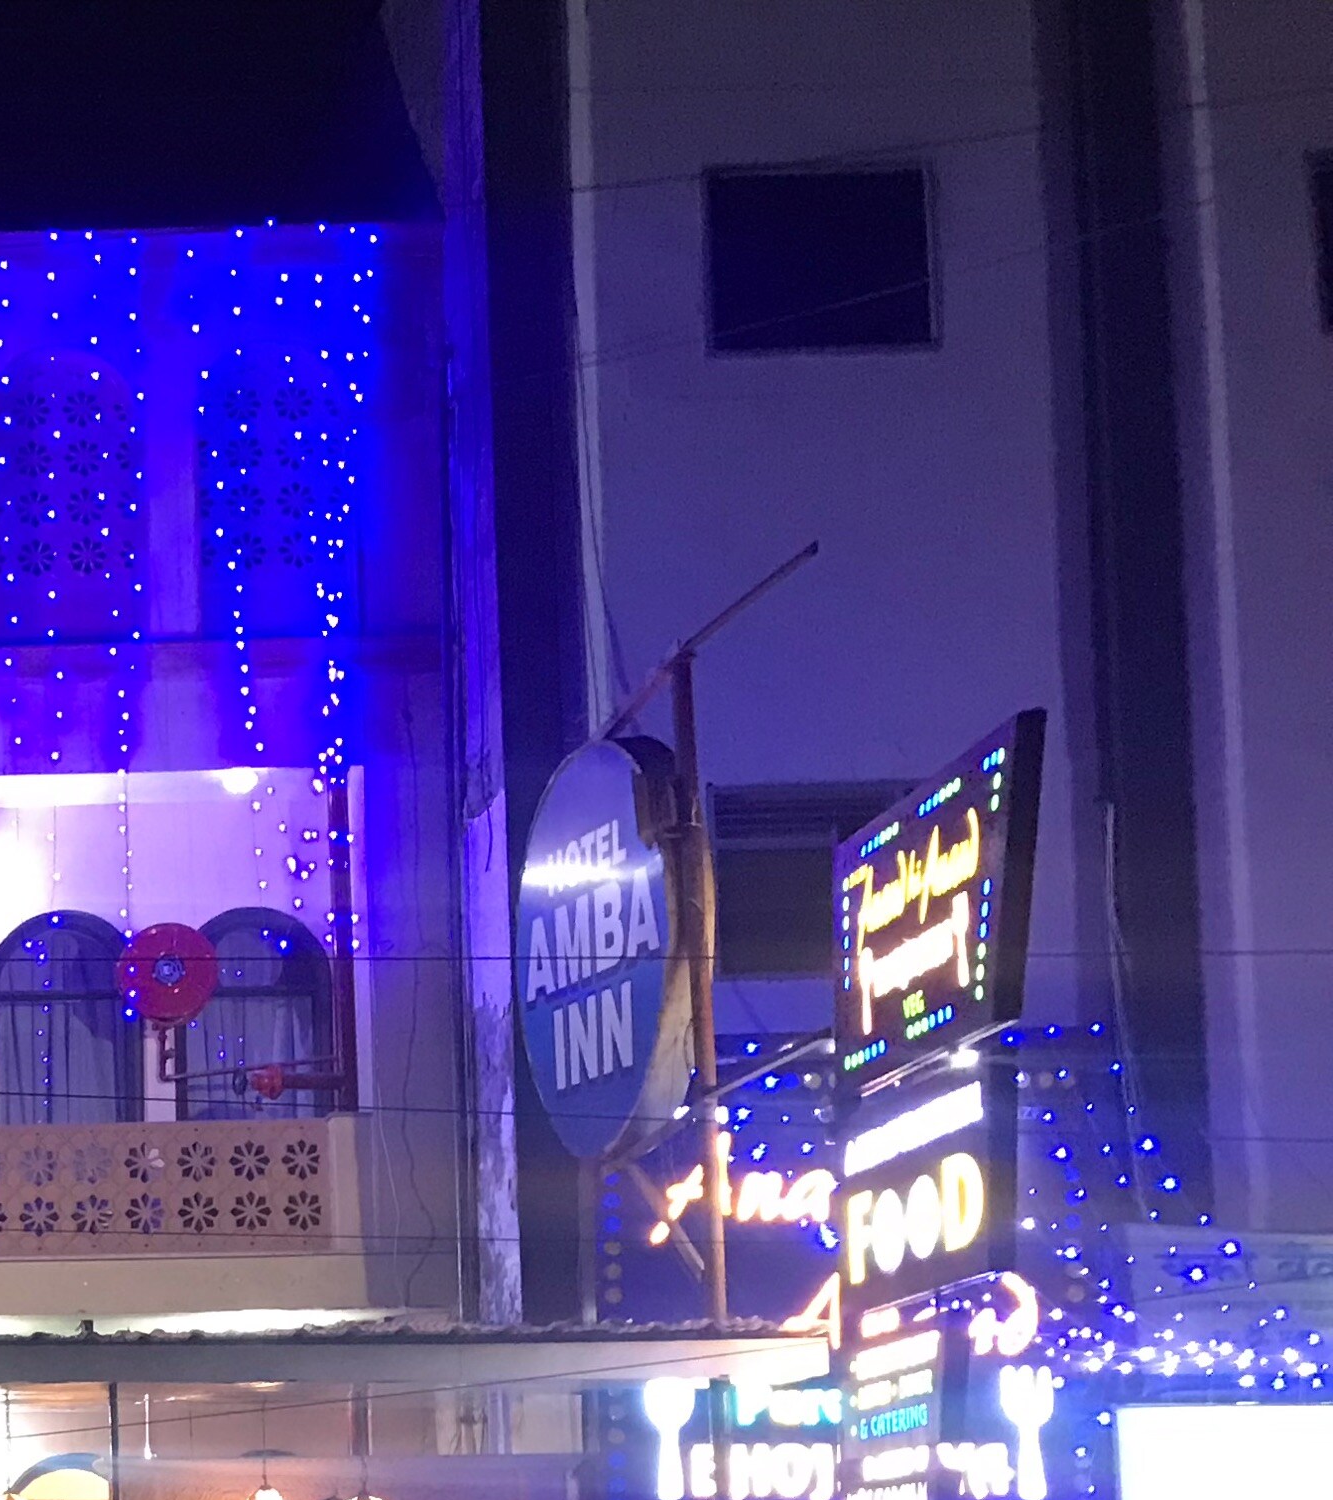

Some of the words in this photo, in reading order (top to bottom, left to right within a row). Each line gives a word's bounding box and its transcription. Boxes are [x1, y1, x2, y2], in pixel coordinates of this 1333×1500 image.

[546, 819, 628, 898] HOTEL
[526, 871, 661, 1003] AMBA
[552, 983, 635, 1091] INN
[847, 1152, 985, 1285] FOOD
[870, 1403, 928, 1438] CATERING
